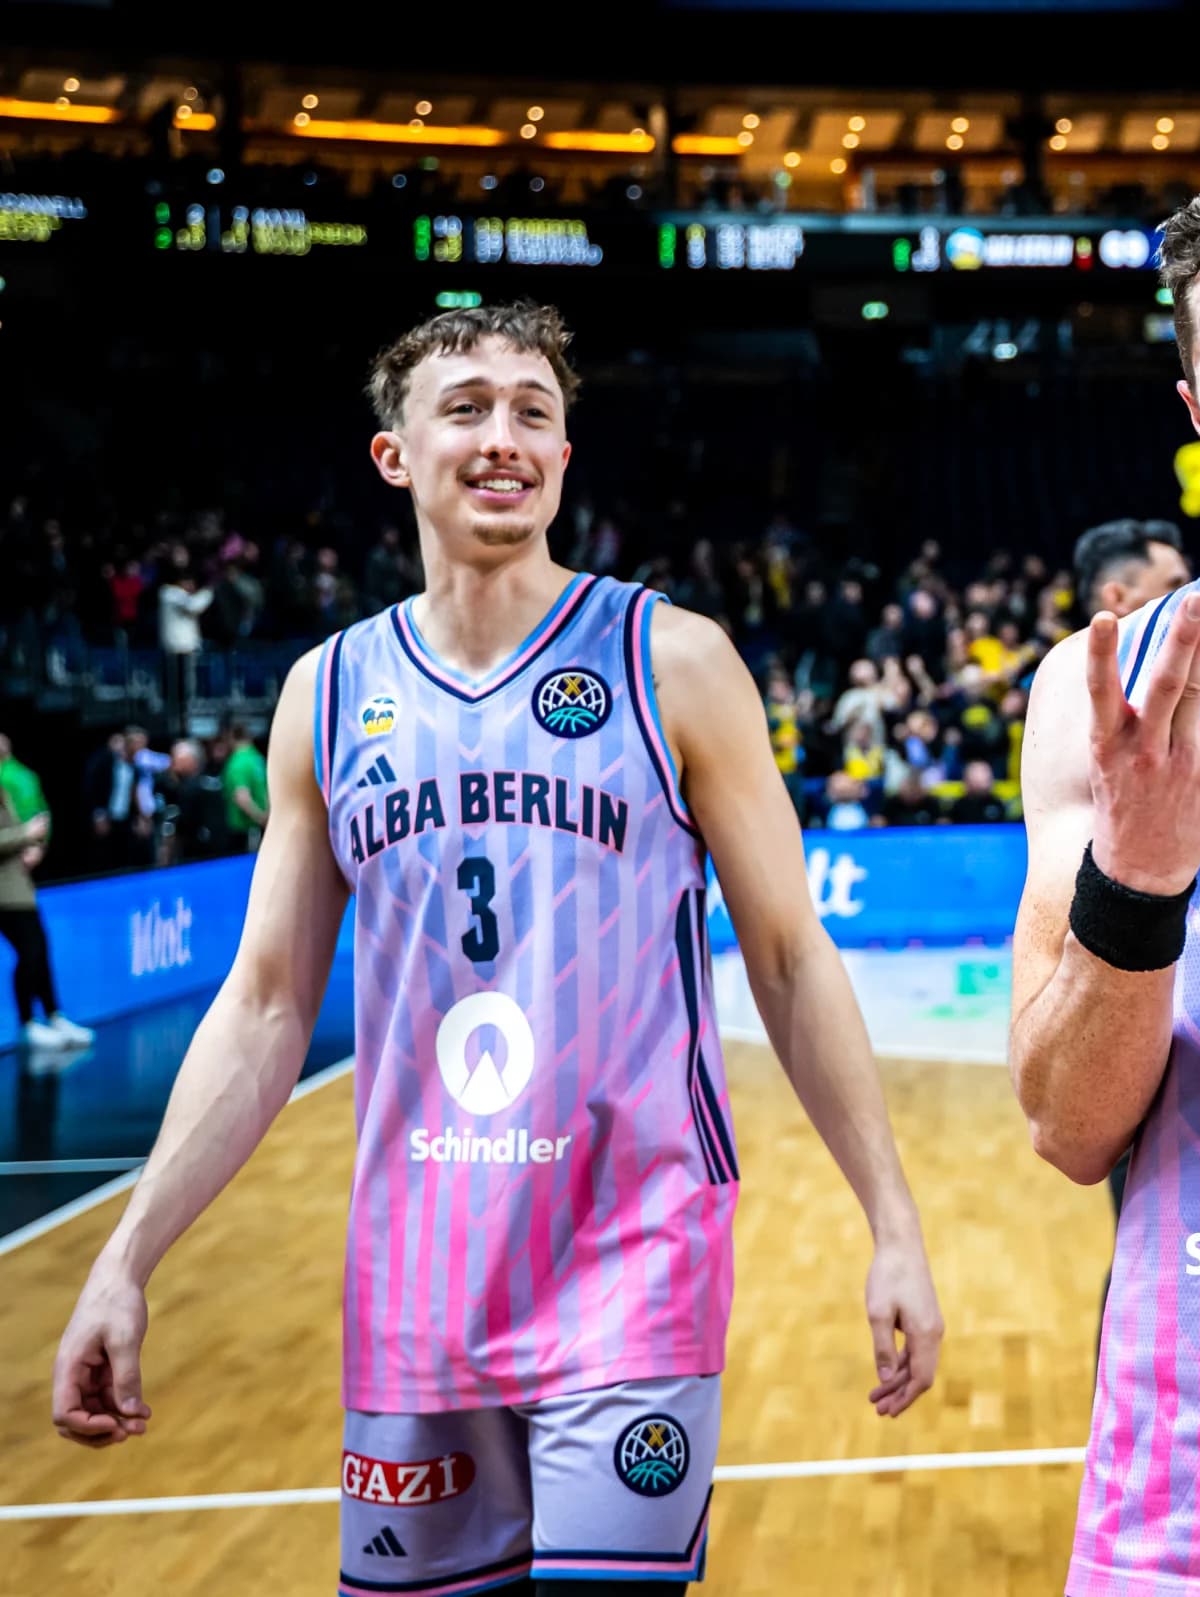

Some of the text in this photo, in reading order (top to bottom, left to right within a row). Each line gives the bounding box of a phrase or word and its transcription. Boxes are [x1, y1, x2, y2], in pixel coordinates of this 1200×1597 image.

[349, 771, 629, 865] ALBA BERLIN
[456, 856, 500, 963] 3
[409, 1128, 572, 1164] Schindler
